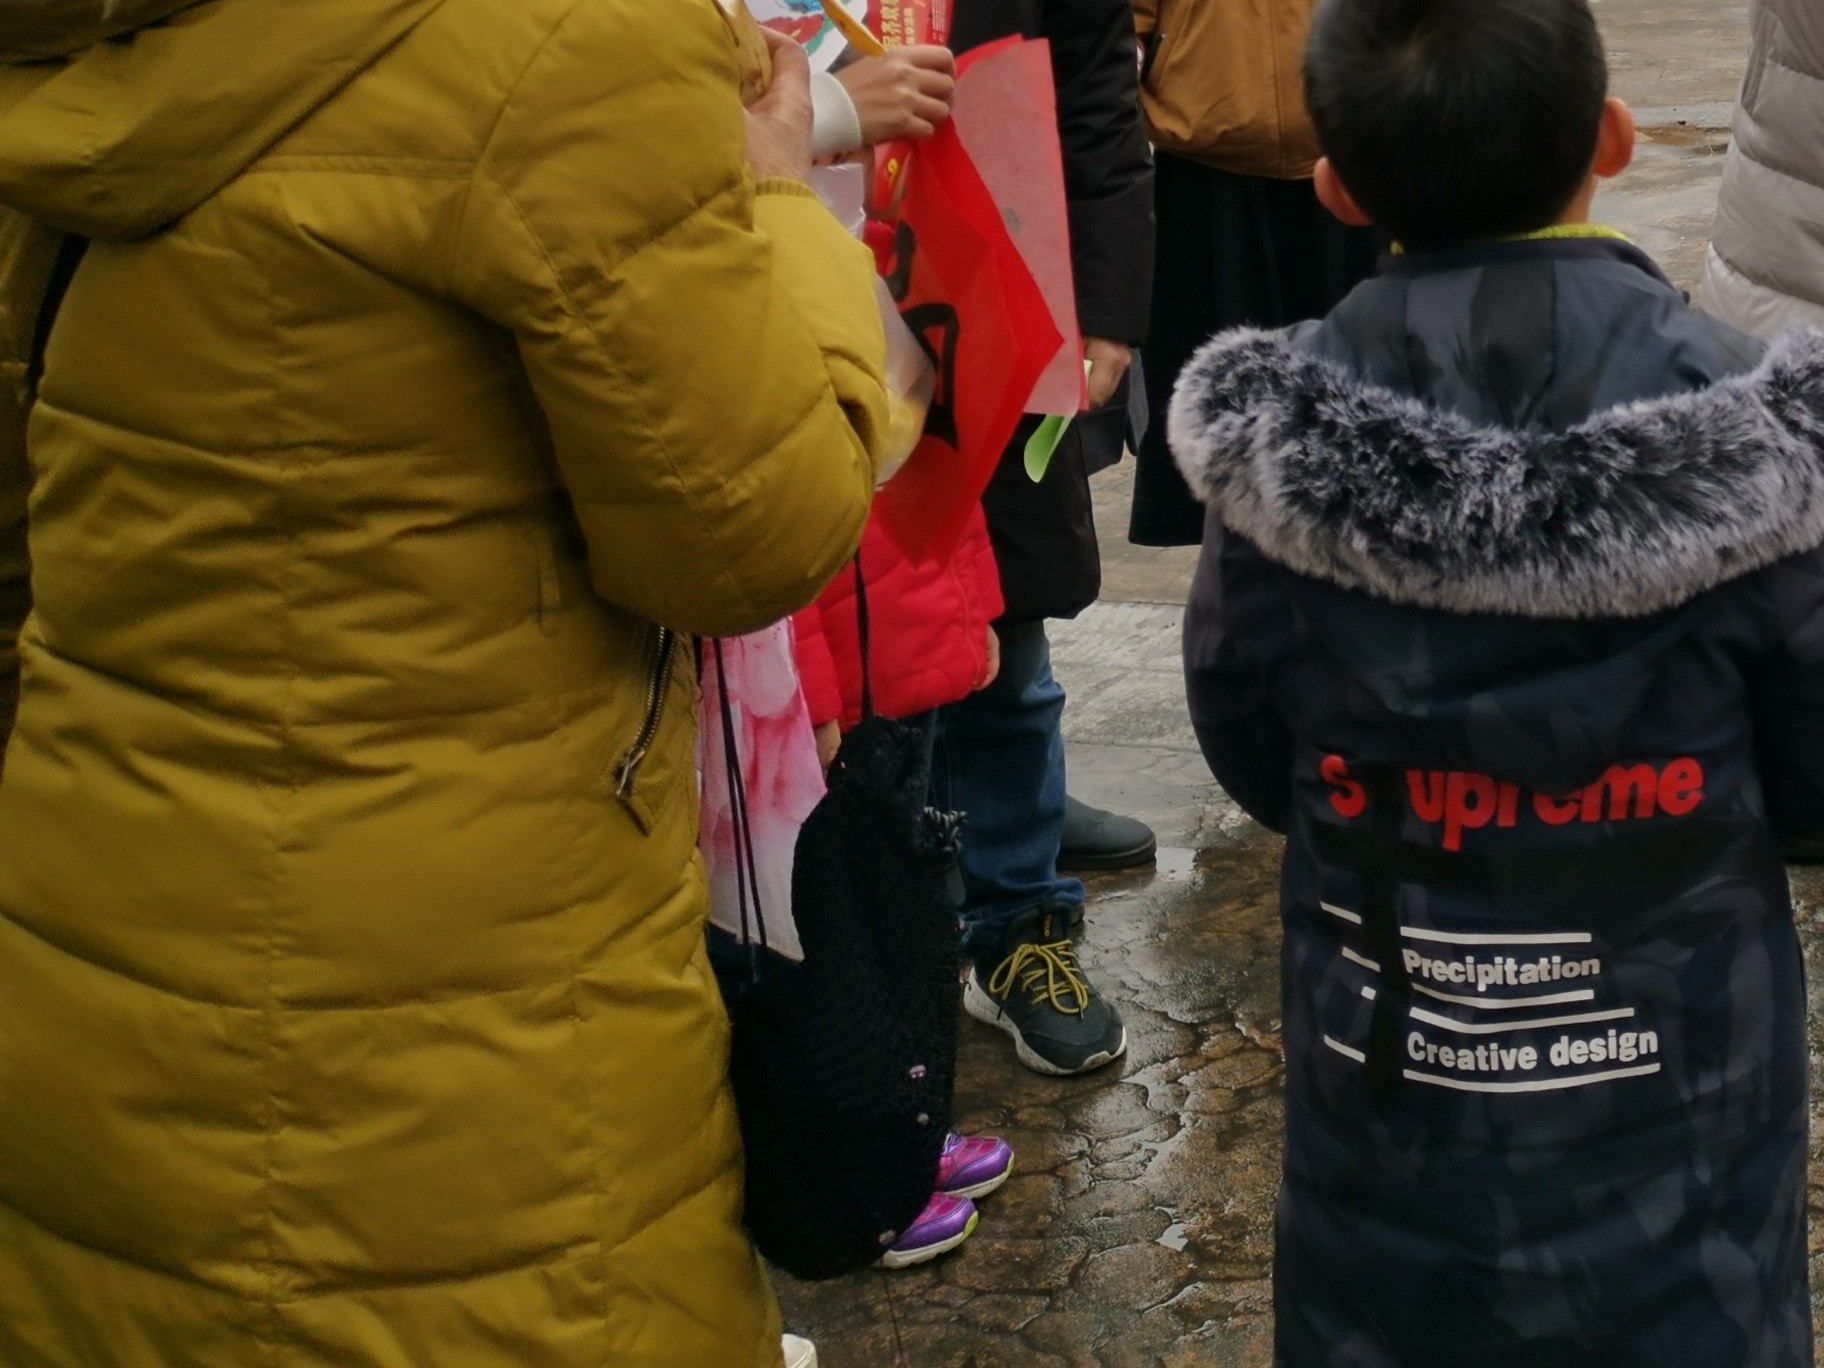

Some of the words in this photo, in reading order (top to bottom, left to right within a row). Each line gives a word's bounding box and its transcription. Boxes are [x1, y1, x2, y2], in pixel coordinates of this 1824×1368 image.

[1402, 948, 1601, 992] Precipitation
[1406, 1031, 1538, 1071] Creative
[1549, 1029, 1659, 1067] design
